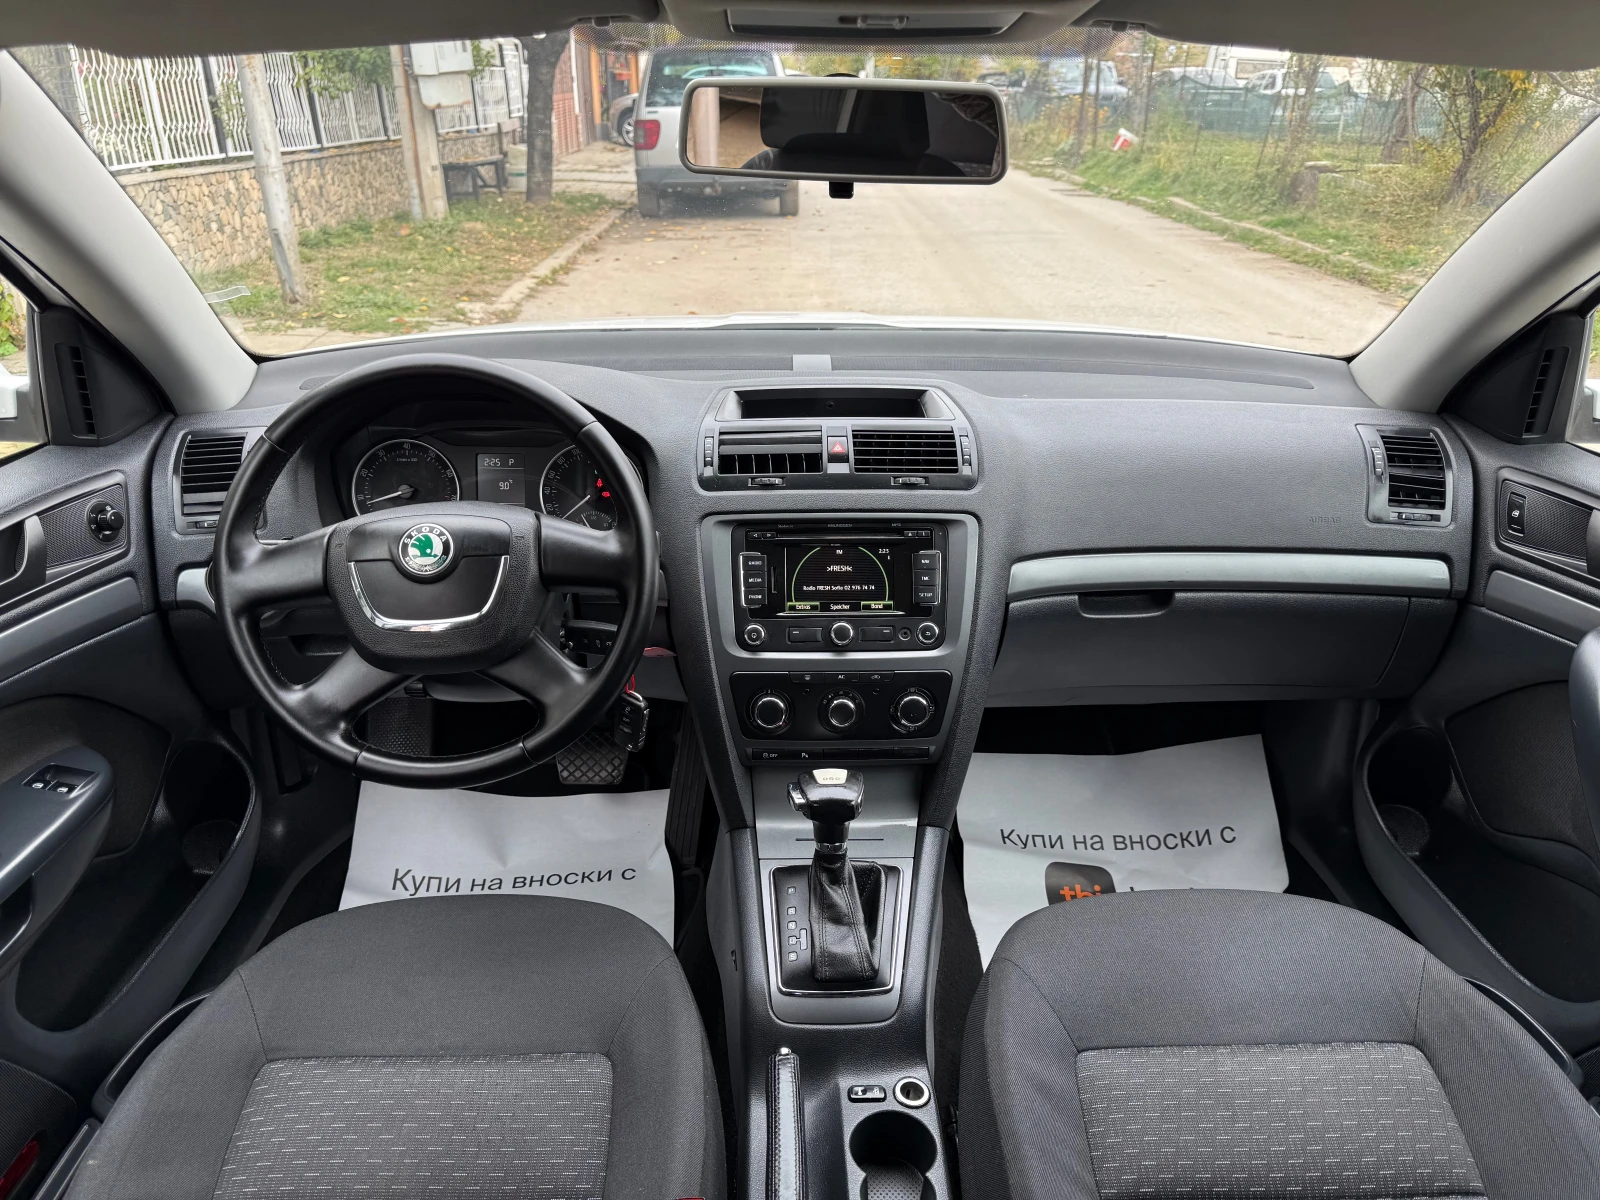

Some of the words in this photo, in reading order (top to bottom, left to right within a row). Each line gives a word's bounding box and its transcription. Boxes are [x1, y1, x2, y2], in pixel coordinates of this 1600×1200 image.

[484, 458, 500, 466] 2:25
[509, 458, 515, 466] P
[360, 469, 368, 477] 20
[548, 470, 555, 479] 60
[544, 487, 551, 495] 40
[546, 503, 554, 512] 20
[830, 603, 850, 611] Speicher
[1000, 829, 1065, 850] Купи
[1073, 834, 1105, 851] на
[1113, 829, 1212, 851] вноски
[391, 868, 462, 897] Купи
[470, 877, 503, 892] на
[512, 869, 613, 889] вноски
